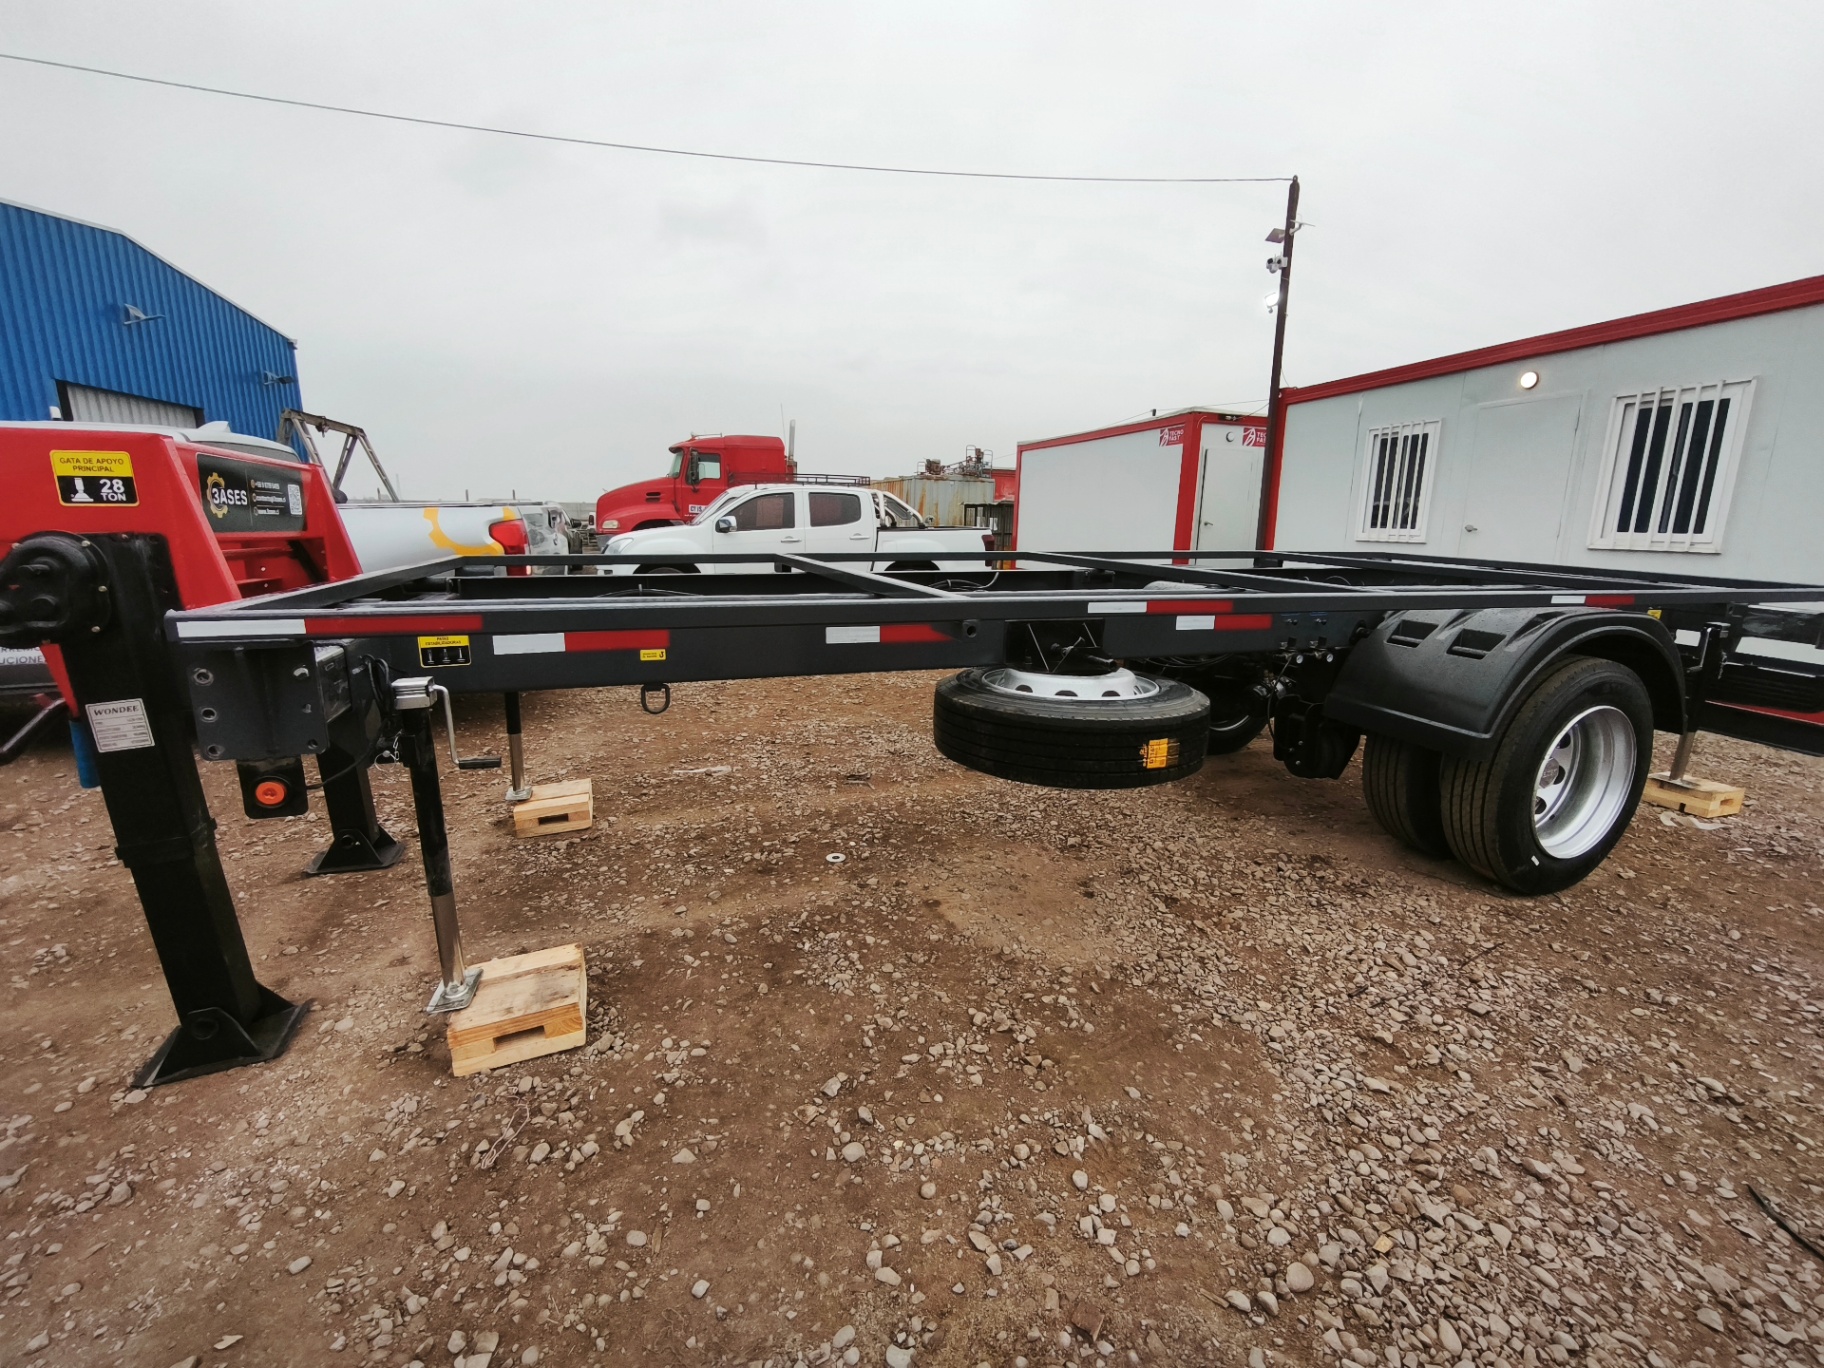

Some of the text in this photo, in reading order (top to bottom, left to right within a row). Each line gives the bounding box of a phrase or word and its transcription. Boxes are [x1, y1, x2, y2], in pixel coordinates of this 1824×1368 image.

[59, 457, 81, 465] GATA
[96, 458, 124, 466] APOYO
[99, 478, 125, 493] 28
[100, 492, 127, 501] TON
[212, 487, 248, 506] 3ASES
[0, 656, 47, 665] UCIONE
[93, 705, 140, 716] WONDEE
